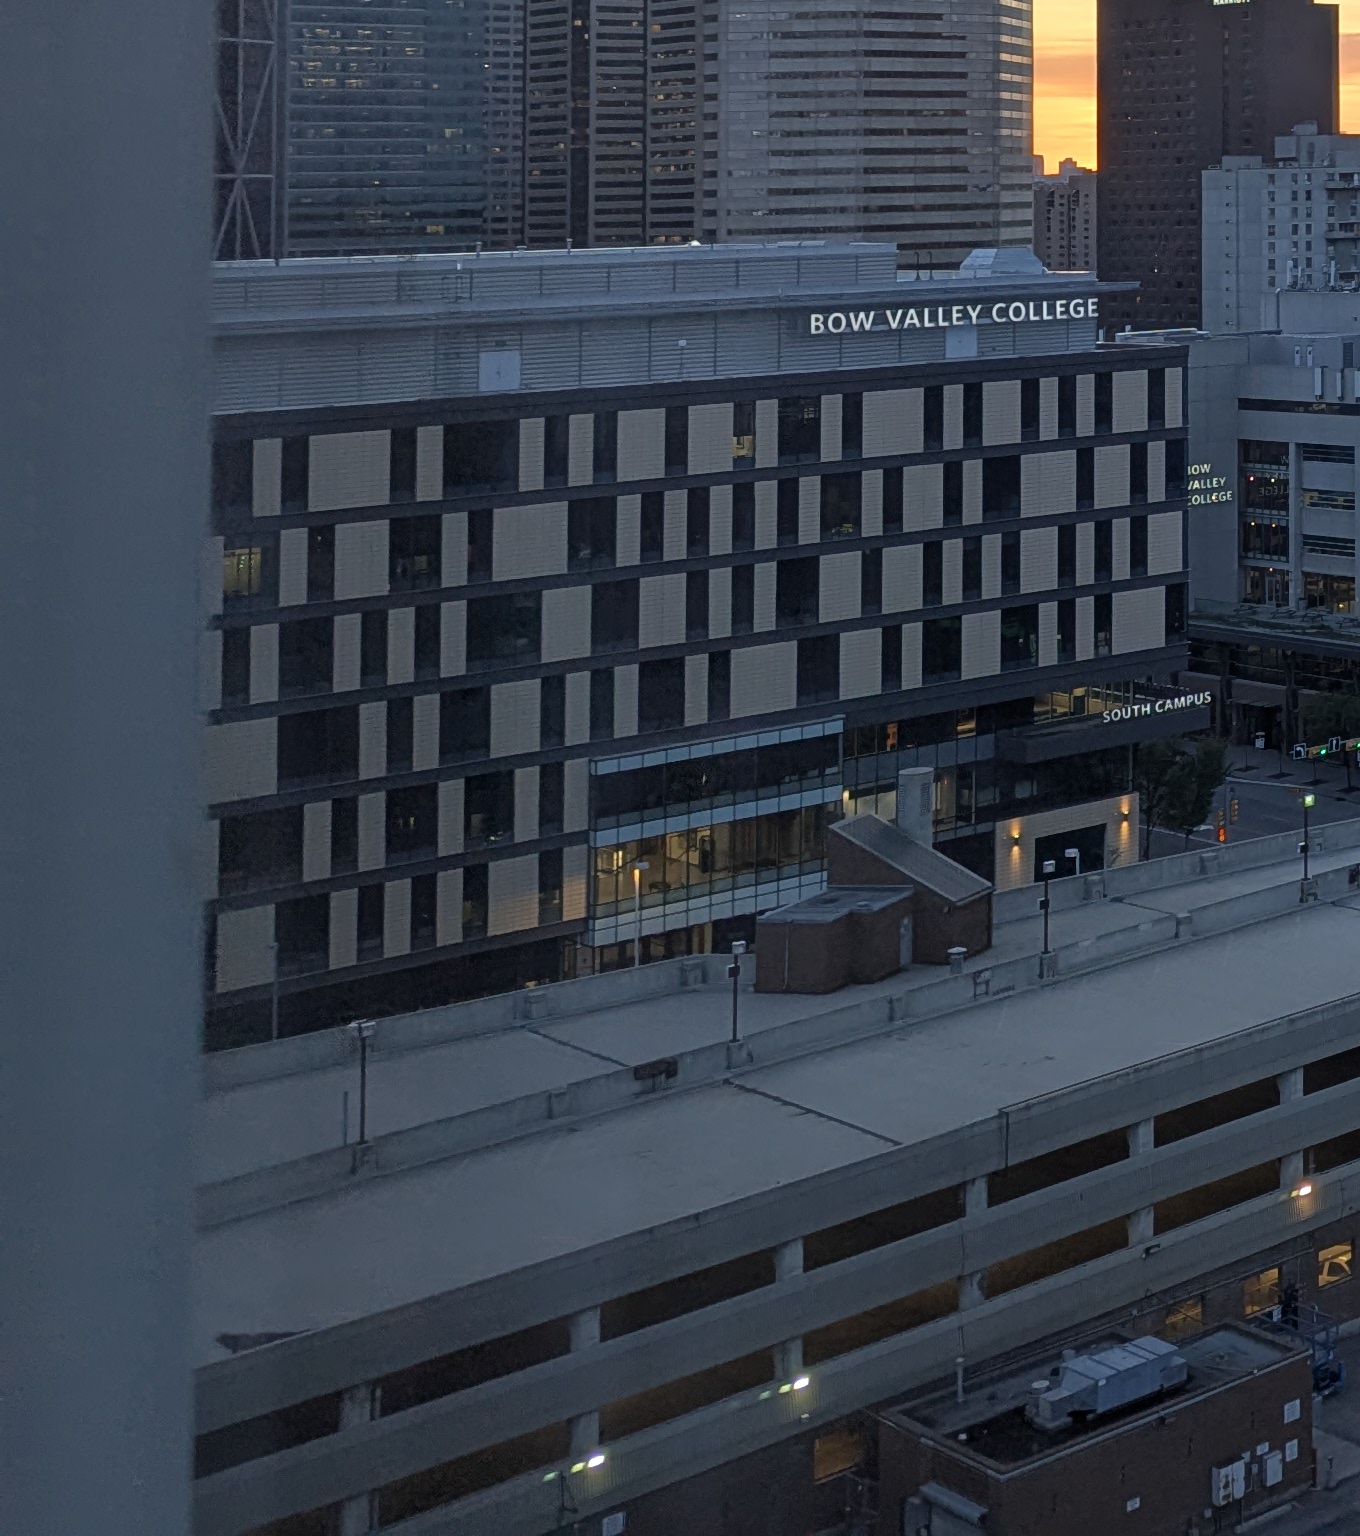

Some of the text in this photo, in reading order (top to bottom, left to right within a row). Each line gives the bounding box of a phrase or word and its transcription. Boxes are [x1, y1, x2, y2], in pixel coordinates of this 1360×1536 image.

[810, 298, 1100, 335] BOW VALLEY COLLEGE
[1102, 691, 1212, 723] SOUTH CAMPUS
